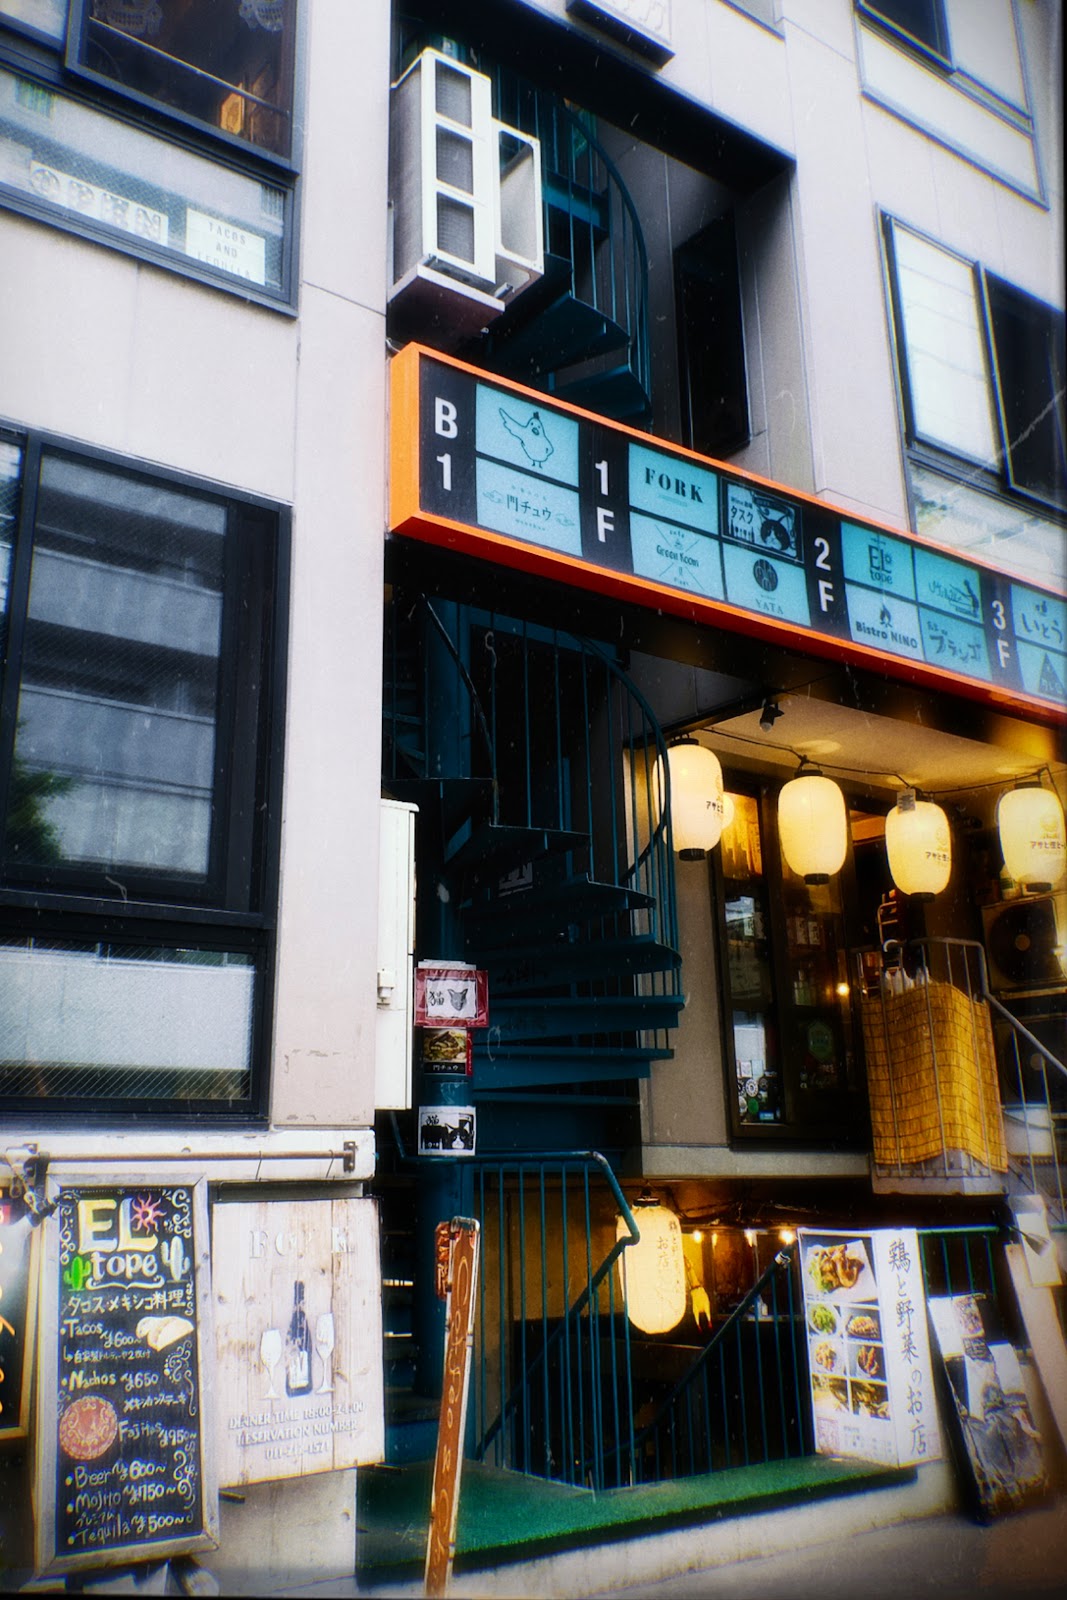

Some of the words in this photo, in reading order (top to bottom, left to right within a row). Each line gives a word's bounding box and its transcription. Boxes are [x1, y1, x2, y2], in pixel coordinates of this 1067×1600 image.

[208, 222, 247, 245] TACOS
[216, 243, 238, 259] AND
[645, 466, 703, 503] FORK
[506, 494, 551, 520] 門チュウ
[730, 505, 754, 525] タスク
[656, 544, 678, 560] Green
[680, 552, 699, 568] Room
[870, 569, 893, 585] tope
[755, 598, 784, 615] YATA
[855, 621, 888, 640] Bistro
[890, 631, 918, 649] NINO
[1021, 612, 1064, 645] いとう
[78, 1197, 158, 1255] EL
[249, 1226, 354, 1259] FOK
[90, 1251, 158, 1281] tope
[63, 1319, 103, 1338] Tacos
[888, 1239, 927, 1457] 鶏と野菜のお店
[69, 1370, 117, 1391] Nachos
[118, 1420, 162, 1442] Fajitas
[228, 1412, 271, 1430] DINNER
[272, 1410, 300, 1424] TIME
[236, 1426, 309, 1447] RESERVATION
[312, 1419, 358, 1436] NUMBER
[75, 1465, 111, 1488] Beer
[75, 1492, 122, 1513] Mojito
[76, 1513, 131, 1545] Tequila
